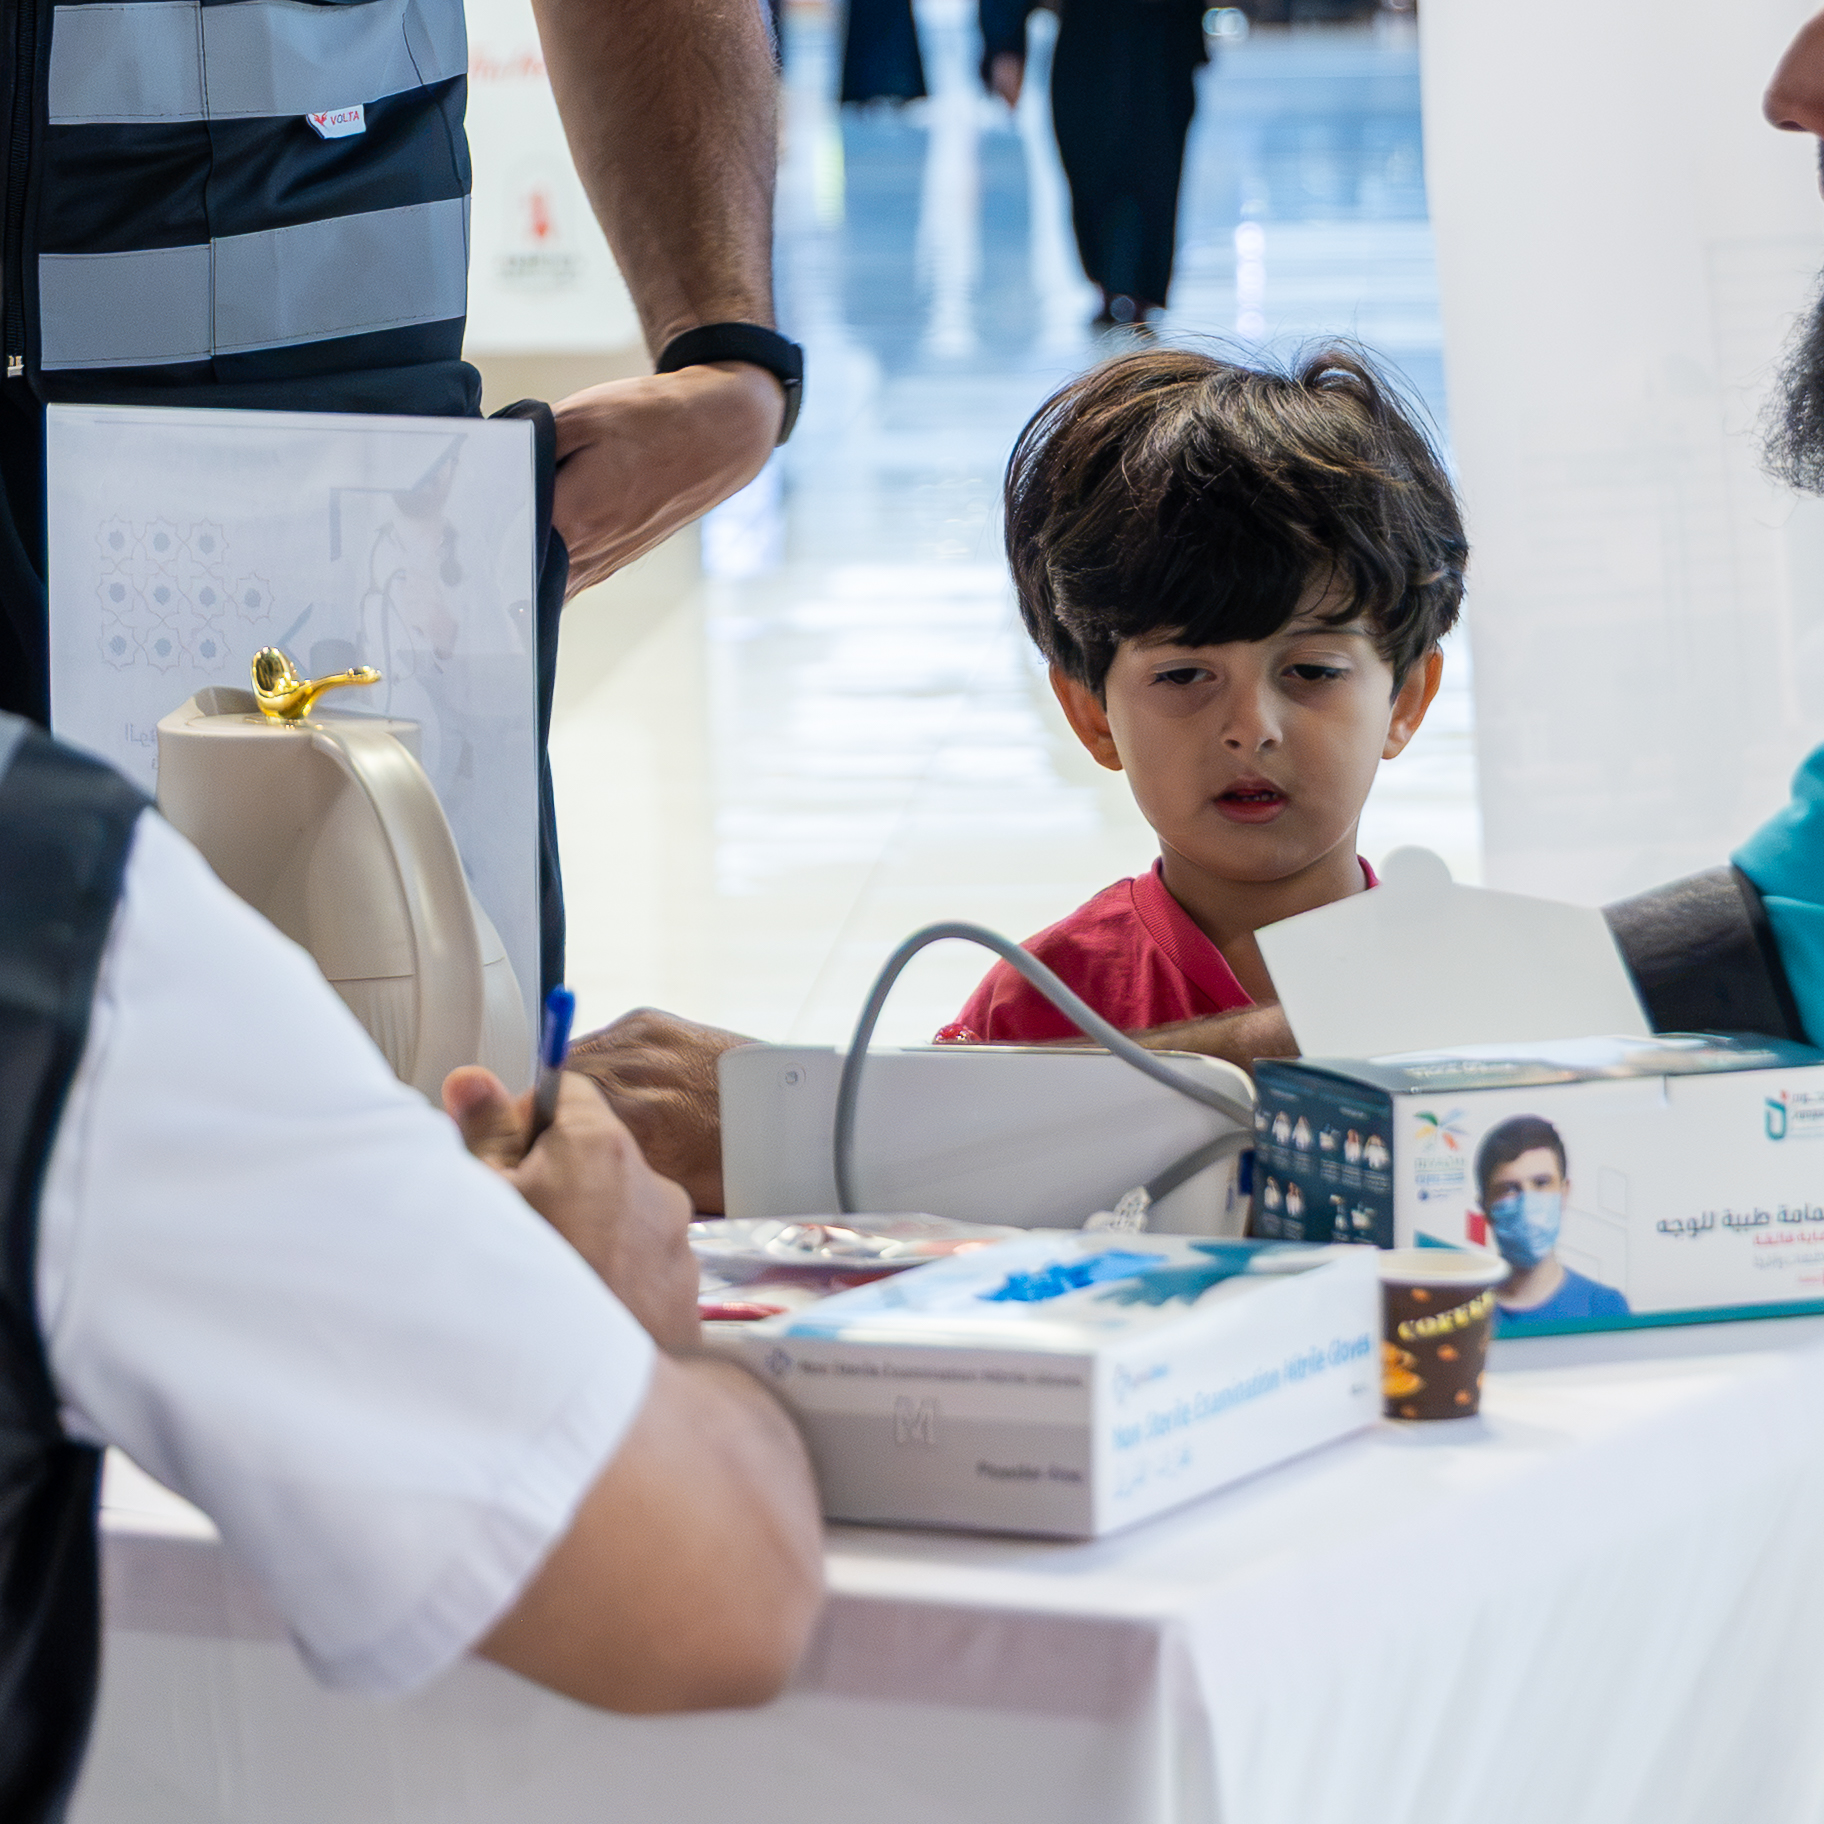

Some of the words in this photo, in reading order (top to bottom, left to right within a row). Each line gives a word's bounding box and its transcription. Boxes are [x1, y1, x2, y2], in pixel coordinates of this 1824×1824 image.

[330, 111, 360, 125] VOLTA
[1656, 1211, 1715, 1238] للوجه
[1722, 1207, 1772, 1232] طبية
[1327, 1332, 1372, 1368] Gloves
